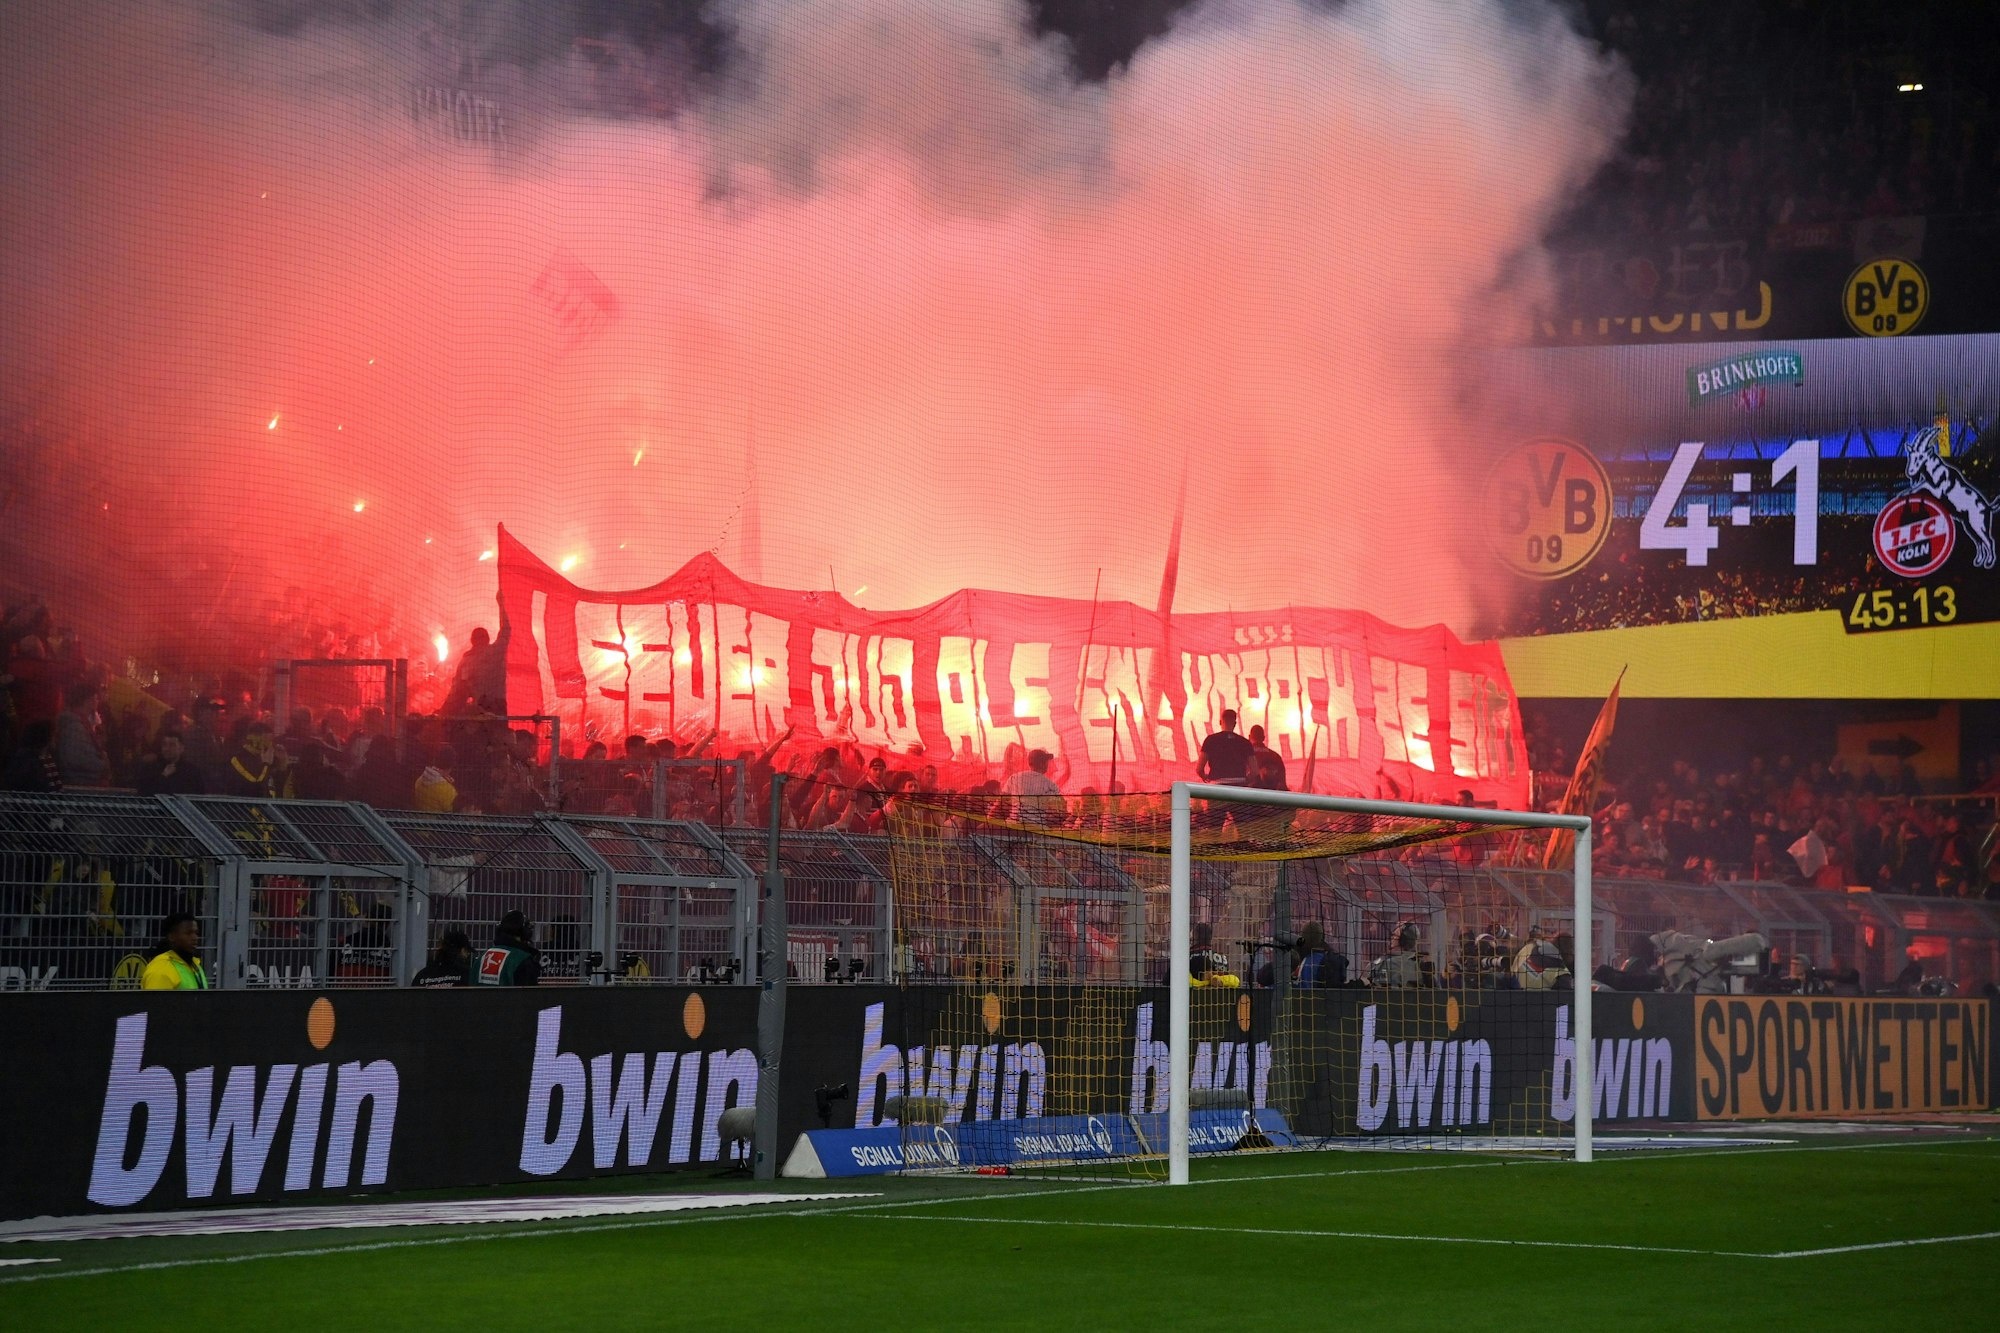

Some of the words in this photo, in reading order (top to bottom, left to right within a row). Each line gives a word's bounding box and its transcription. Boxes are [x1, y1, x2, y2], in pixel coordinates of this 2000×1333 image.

[1855, 265, 1919, 317] BVB
[1872, 314, 1897, 333] 09
[1500, 453, 1597, 536] BVB
[1639, 439, 1820, 567] 4:1
[1526, 534, 1564, 564] 09
[1896, 541, 1931, 564] KÖLN
[1849, 586, 1958, 629] 45:13
[531, 590, 791, 746] LEEVER
[936, 635, 1062, 764] ALS
[87, 997, 400, 1208] bwin
[518, 992, 757, 1176] bwin
[856, 992, 1047, 1130] bwin
[1357, 997, 1493, 1131] bwin
[1551, 997, 1673, 1122] bwin
[1700, 998, 1986, 1117] SPORTWETTEN
[851, 1145, 903, 1167] SIGNAL
[899, 1143, 941, 1164] IDUNA
[1014, 1135, 1060, 1155] SIGNAL
[1056, 1134, 1096, 1152] IDUNA
